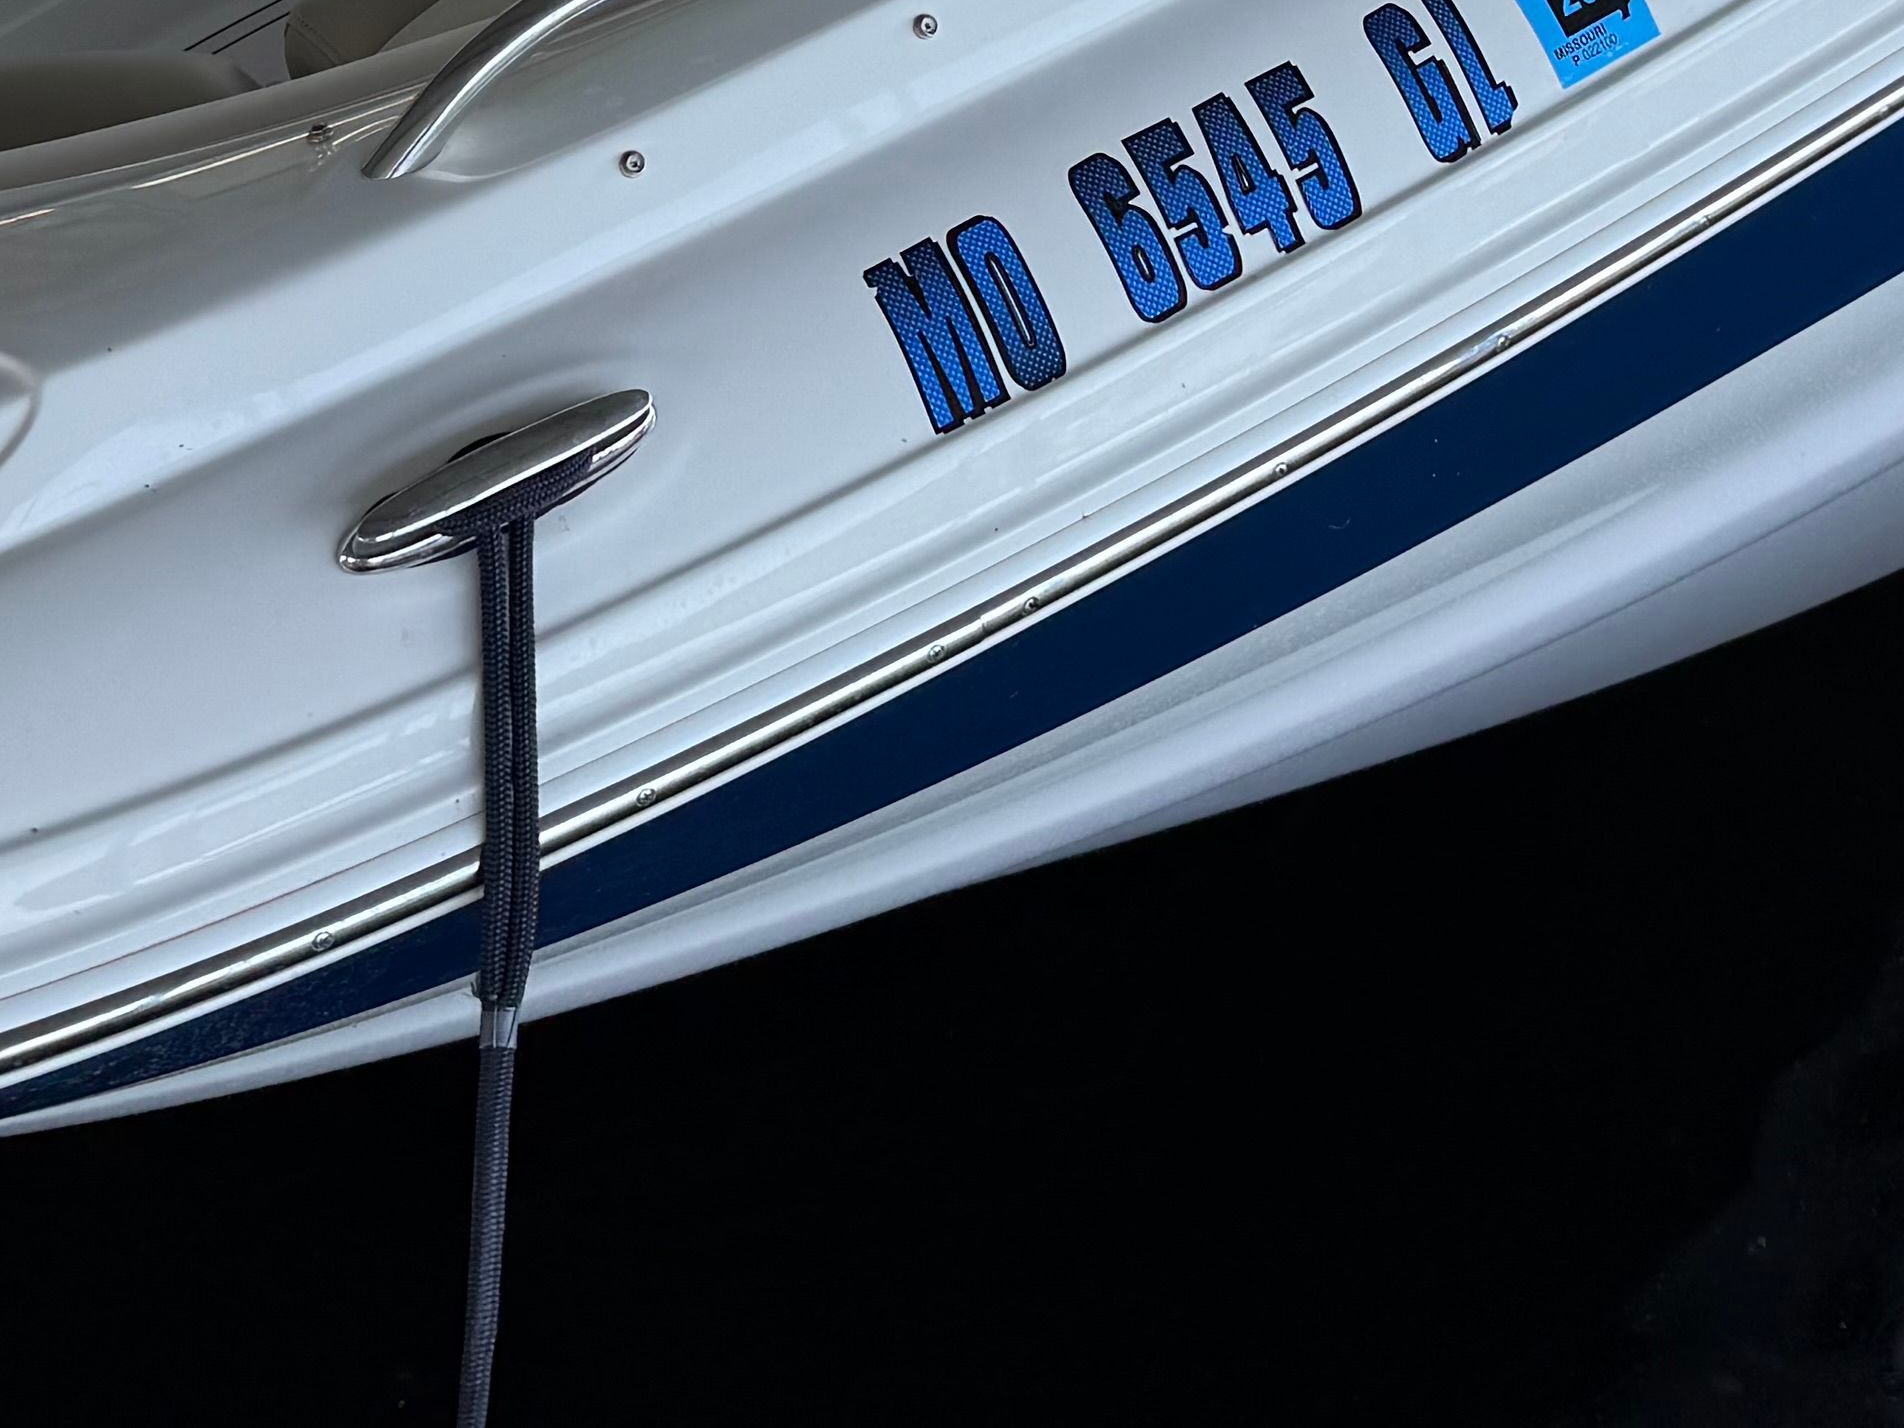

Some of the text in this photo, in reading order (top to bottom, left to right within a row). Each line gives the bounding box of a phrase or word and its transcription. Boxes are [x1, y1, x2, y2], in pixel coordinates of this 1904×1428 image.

[1553, 22, 1608, 61] MISSOURI
[863, 214, 1066, 435] MO
[1068, 61, 1363, 324] 6545
